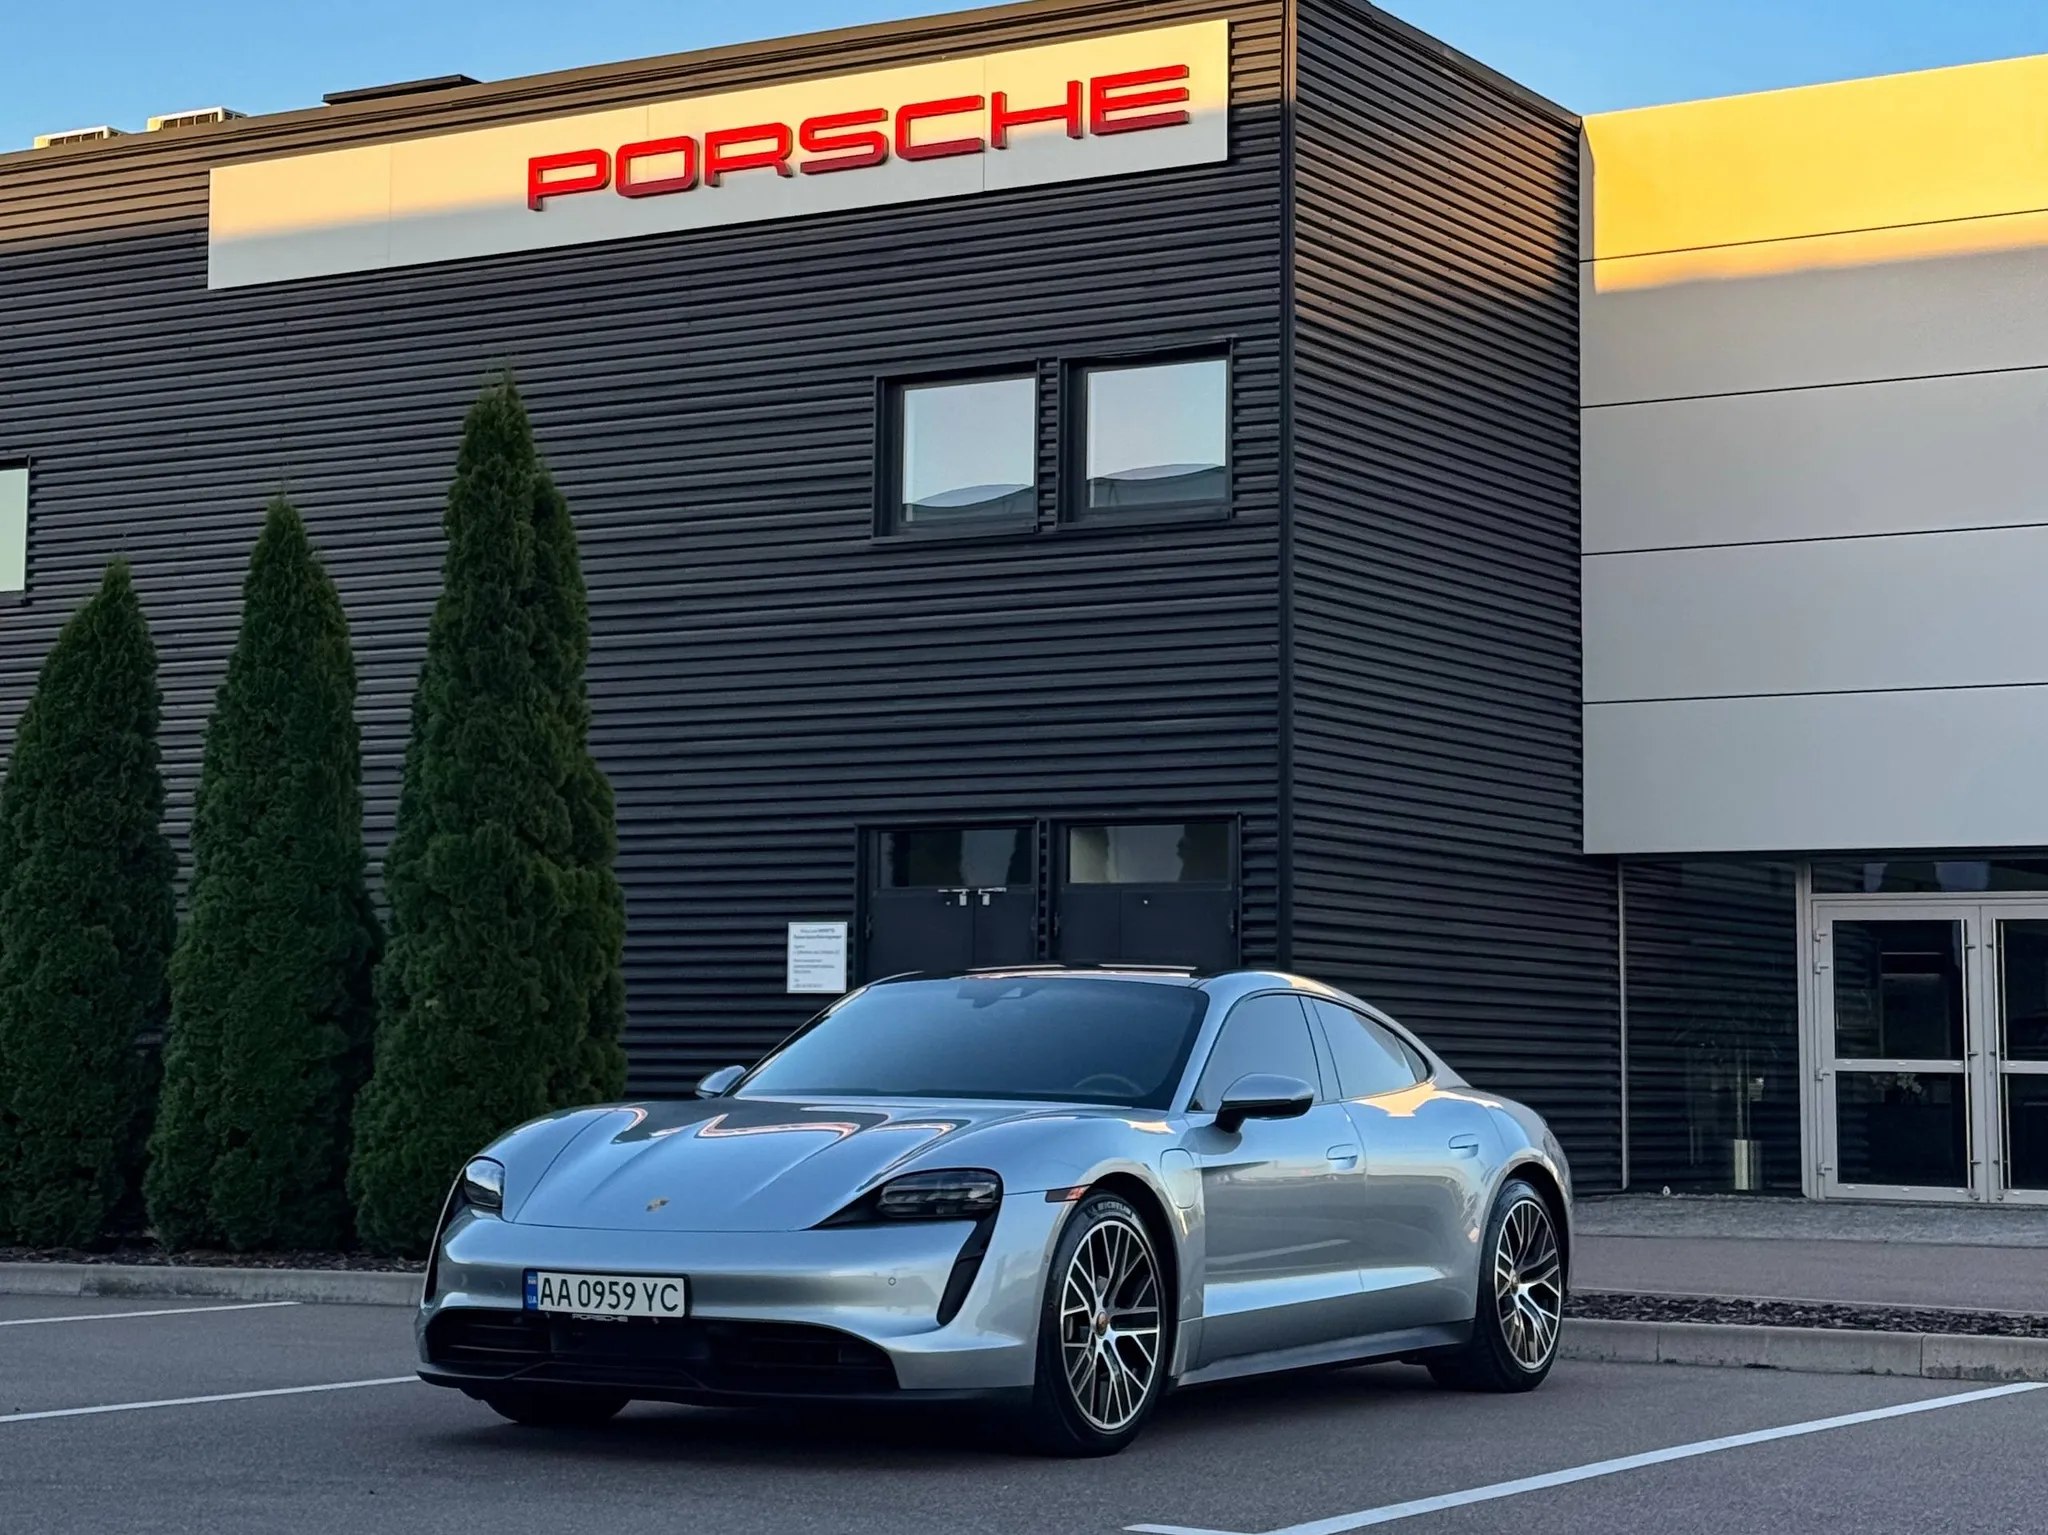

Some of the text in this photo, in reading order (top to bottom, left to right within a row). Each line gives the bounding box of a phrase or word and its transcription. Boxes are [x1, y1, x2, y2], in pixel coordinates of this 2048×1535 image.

[527, 63, 1190, 211] PORSCHE
[540, 1277, 679, 1312] AA 0959 YC
